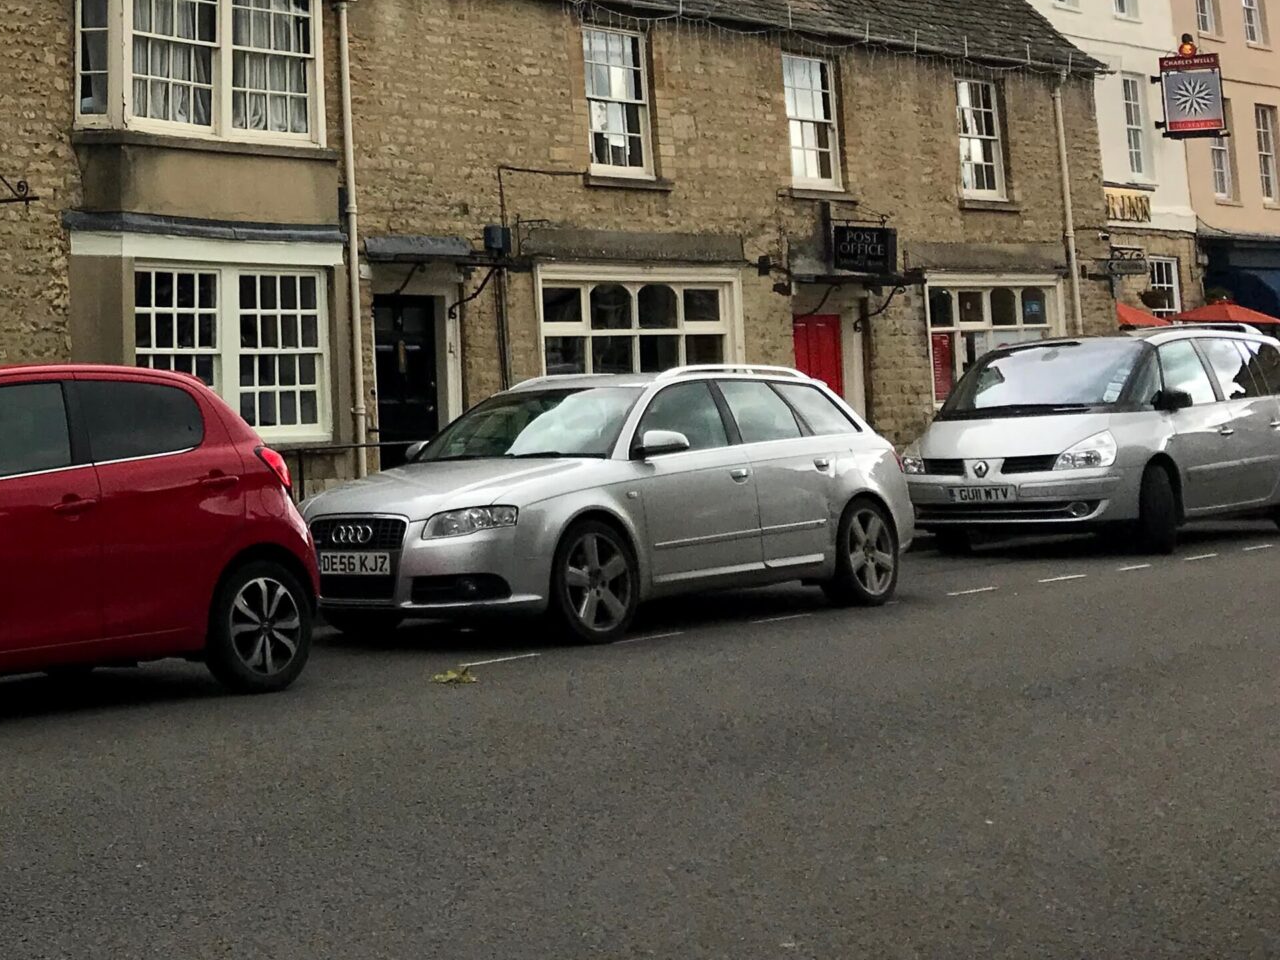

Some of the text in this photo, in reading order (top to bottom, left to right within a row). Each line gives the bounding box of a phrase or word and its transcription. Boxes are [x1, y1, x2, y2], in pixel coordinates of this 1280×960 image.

[846, 230, 879, 243] POST
[840, 242, 885, 256] OFFICE
[960, 487, 1008, 501] GU11 WTV
[322, 555, 356, 572] DE56
